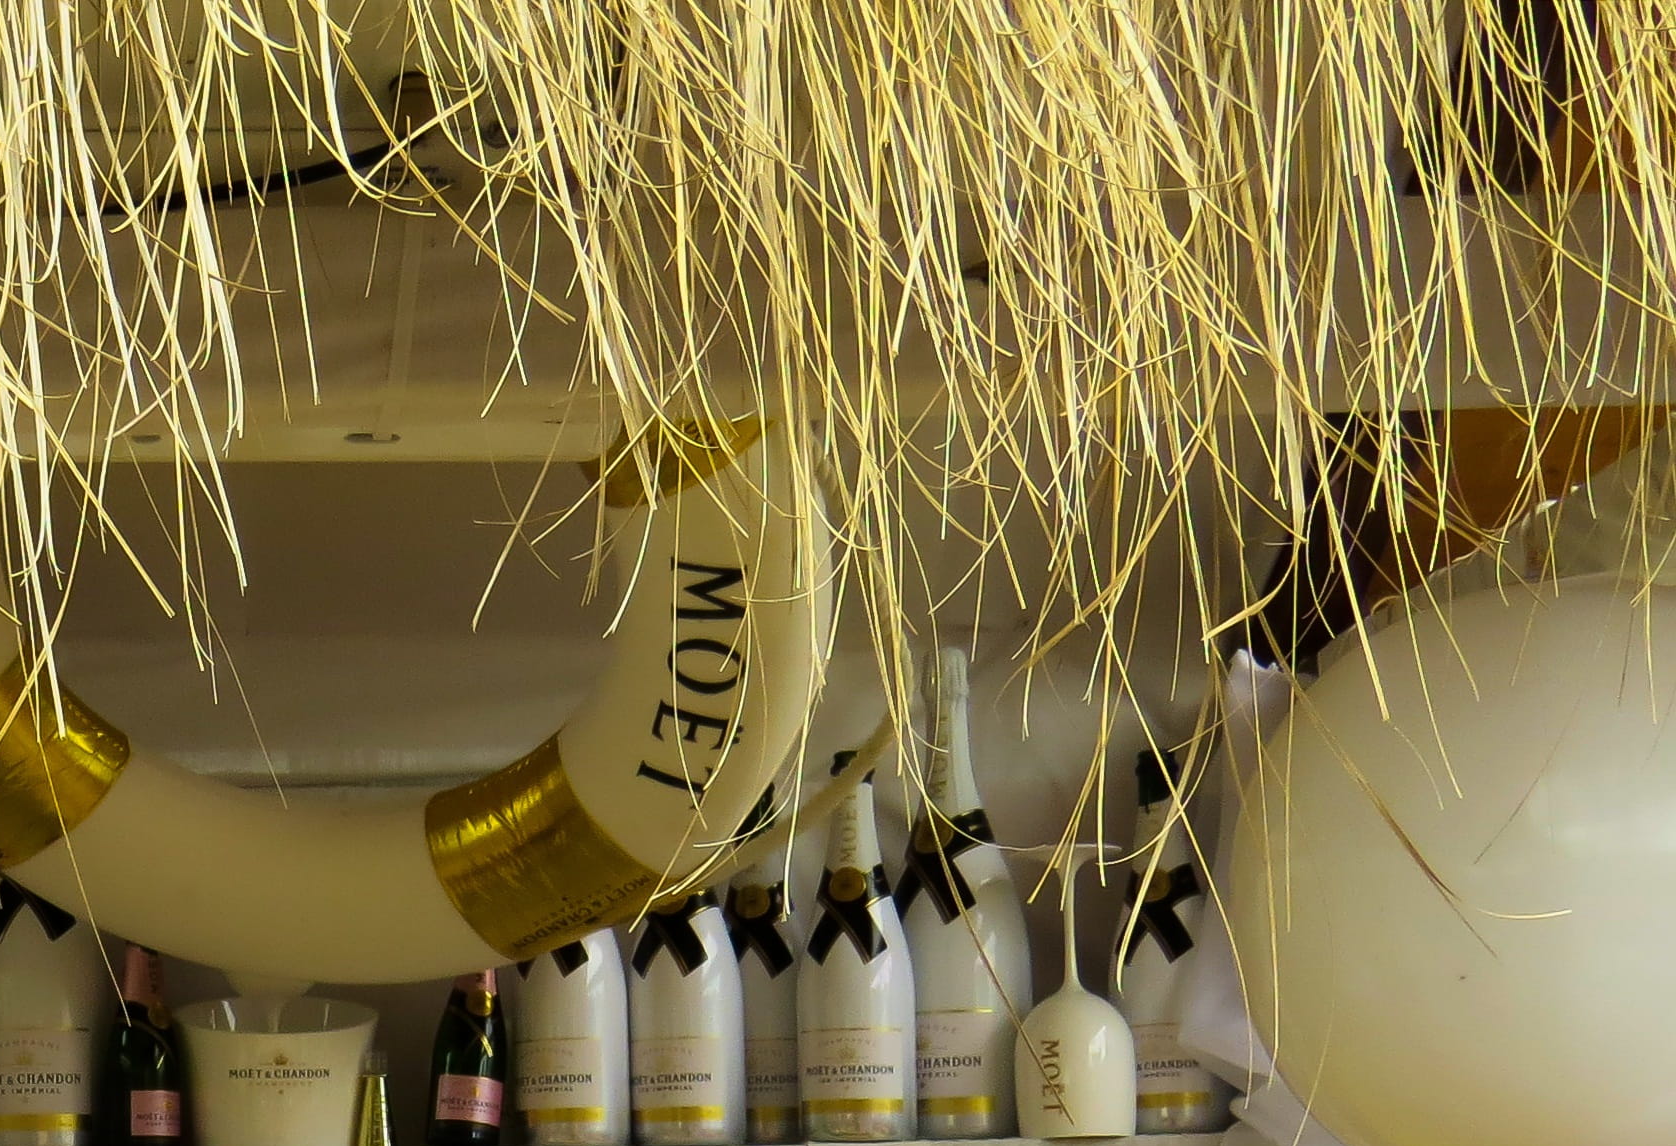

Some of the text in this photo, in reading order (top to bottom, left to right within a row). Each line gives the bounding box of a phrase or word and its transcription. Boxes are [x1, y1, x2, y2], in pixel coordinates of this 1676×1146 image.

[637, 557, 747, 810] MOËT
[916, 1056, 981, 1070] CHANDON
[1144, 1059, 1199, 1070] CHANDON
[229, 1069, 262, 1079] MOËT
[274, 1069, 329, 1078] CHANDON
[840, 1065, 893, 1074] CHANDON
[7, 1076, 14, 1085] &
[17, 1073, 80, 1084] CHANDON
[539, 1074, 592, 1084] CHANDON
[657, 1073, 711, 1083] CHANDON
